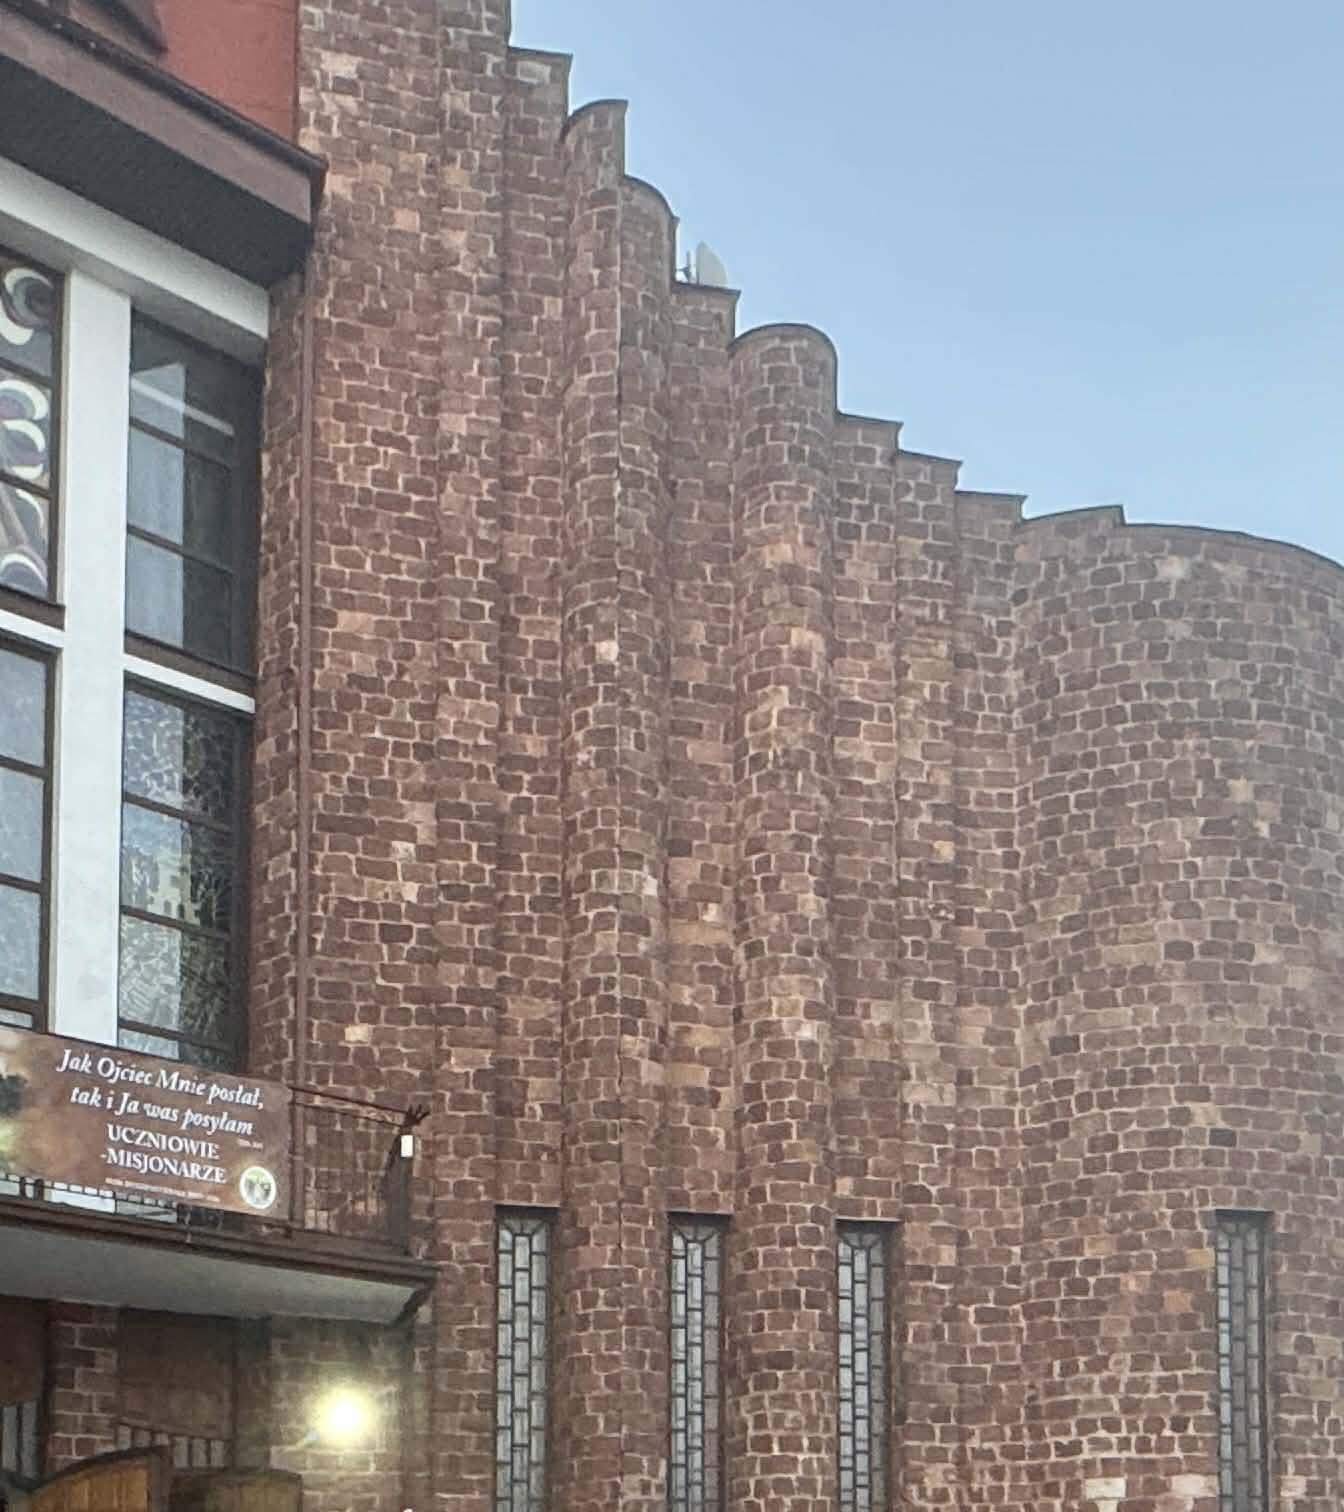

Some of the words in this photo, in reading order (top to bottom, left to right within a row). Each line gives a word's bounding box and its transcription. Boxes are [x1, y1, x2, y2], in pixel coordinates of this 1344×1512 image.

[56, 1049, 92, 1074] Jak
[97, 1057, 153, 1085] Ojciec
[155, 1069, 206, 1096] Mnie
[207, 1083, 264, 1110] posłał,
[70, 1086, 101, 1109] tak
[106, 1090, 115, 1109] i
[114, 1092, 139, 1116] Ja
[143, 1103, 178, 1122] was
[181, 1107, 255, 1136] posyłam
[107, 1124, 221, 1160] UCZNIOWIE
